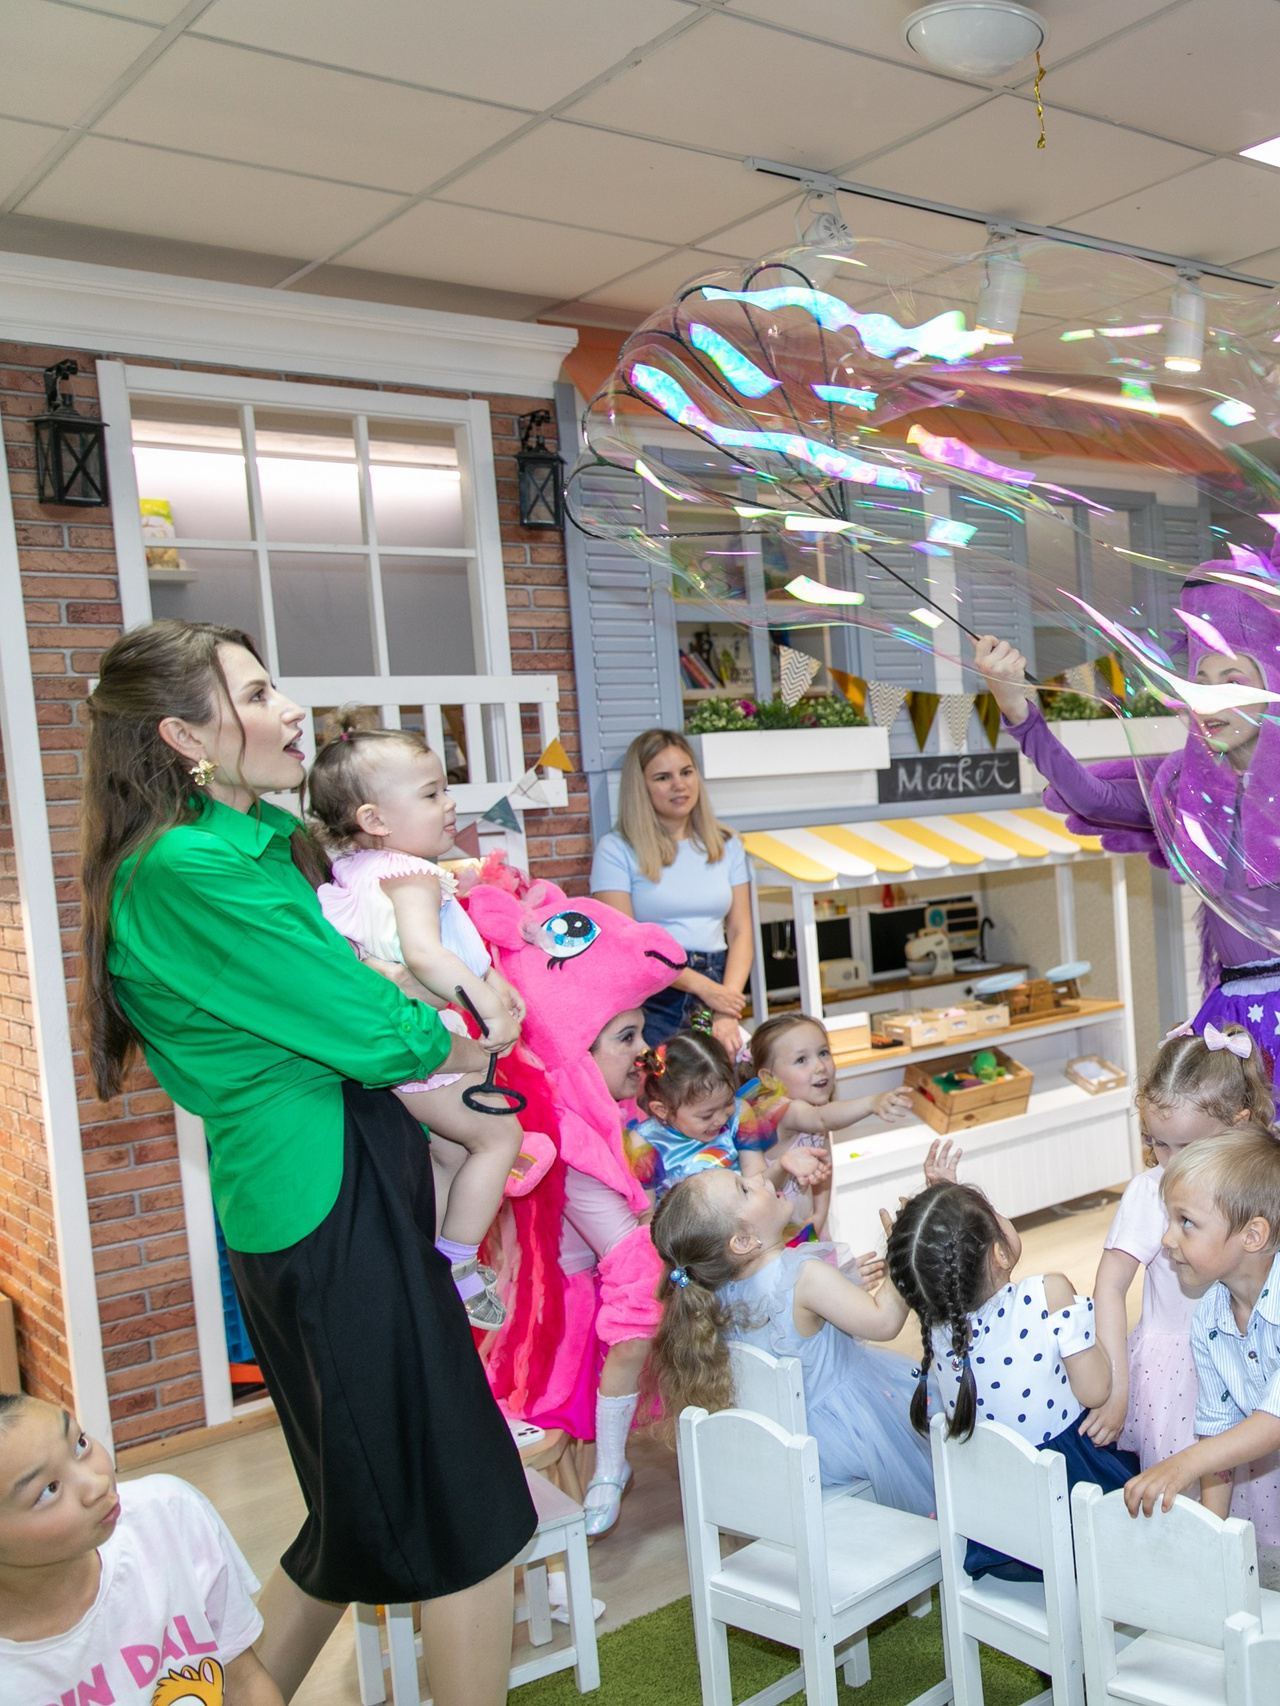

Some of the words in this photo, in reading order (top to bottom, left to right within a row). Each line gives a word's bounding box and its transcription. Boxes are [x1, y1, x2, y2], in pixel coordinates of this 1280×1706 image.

[898, 757, 1016, 793] Market
[44, 1663, 116, 1706] IN
[120, 1611, 219, 1690] DAL
